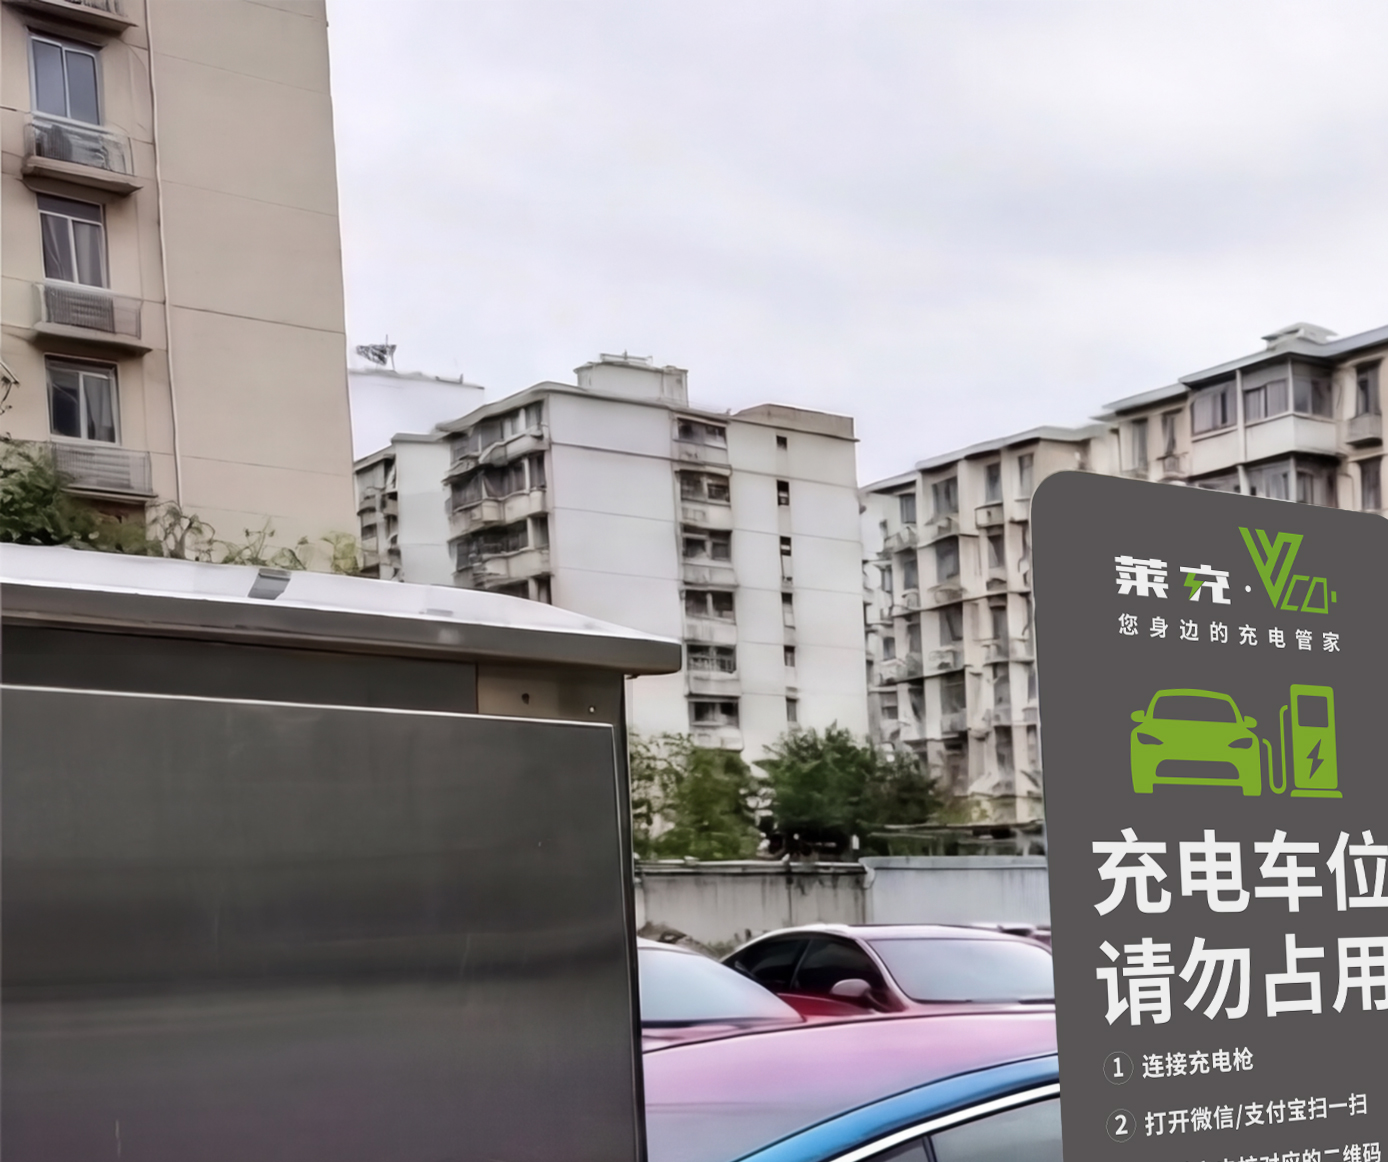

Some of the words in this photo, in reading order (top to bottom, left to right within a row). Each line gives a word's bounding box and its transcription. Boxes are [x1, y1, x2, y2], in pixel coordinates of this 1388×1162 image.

[1118, 613, 1341, 653] 您身边的充电管家
[1113, 1057, 1124, 1078] 1
[1142, 1046, 1254, 1079] 连接充电枪
[1114, 1114, 1128, 1136] 2
[1145, 1092, 1368, 1137] 打开微信/支付宝扫一扫
